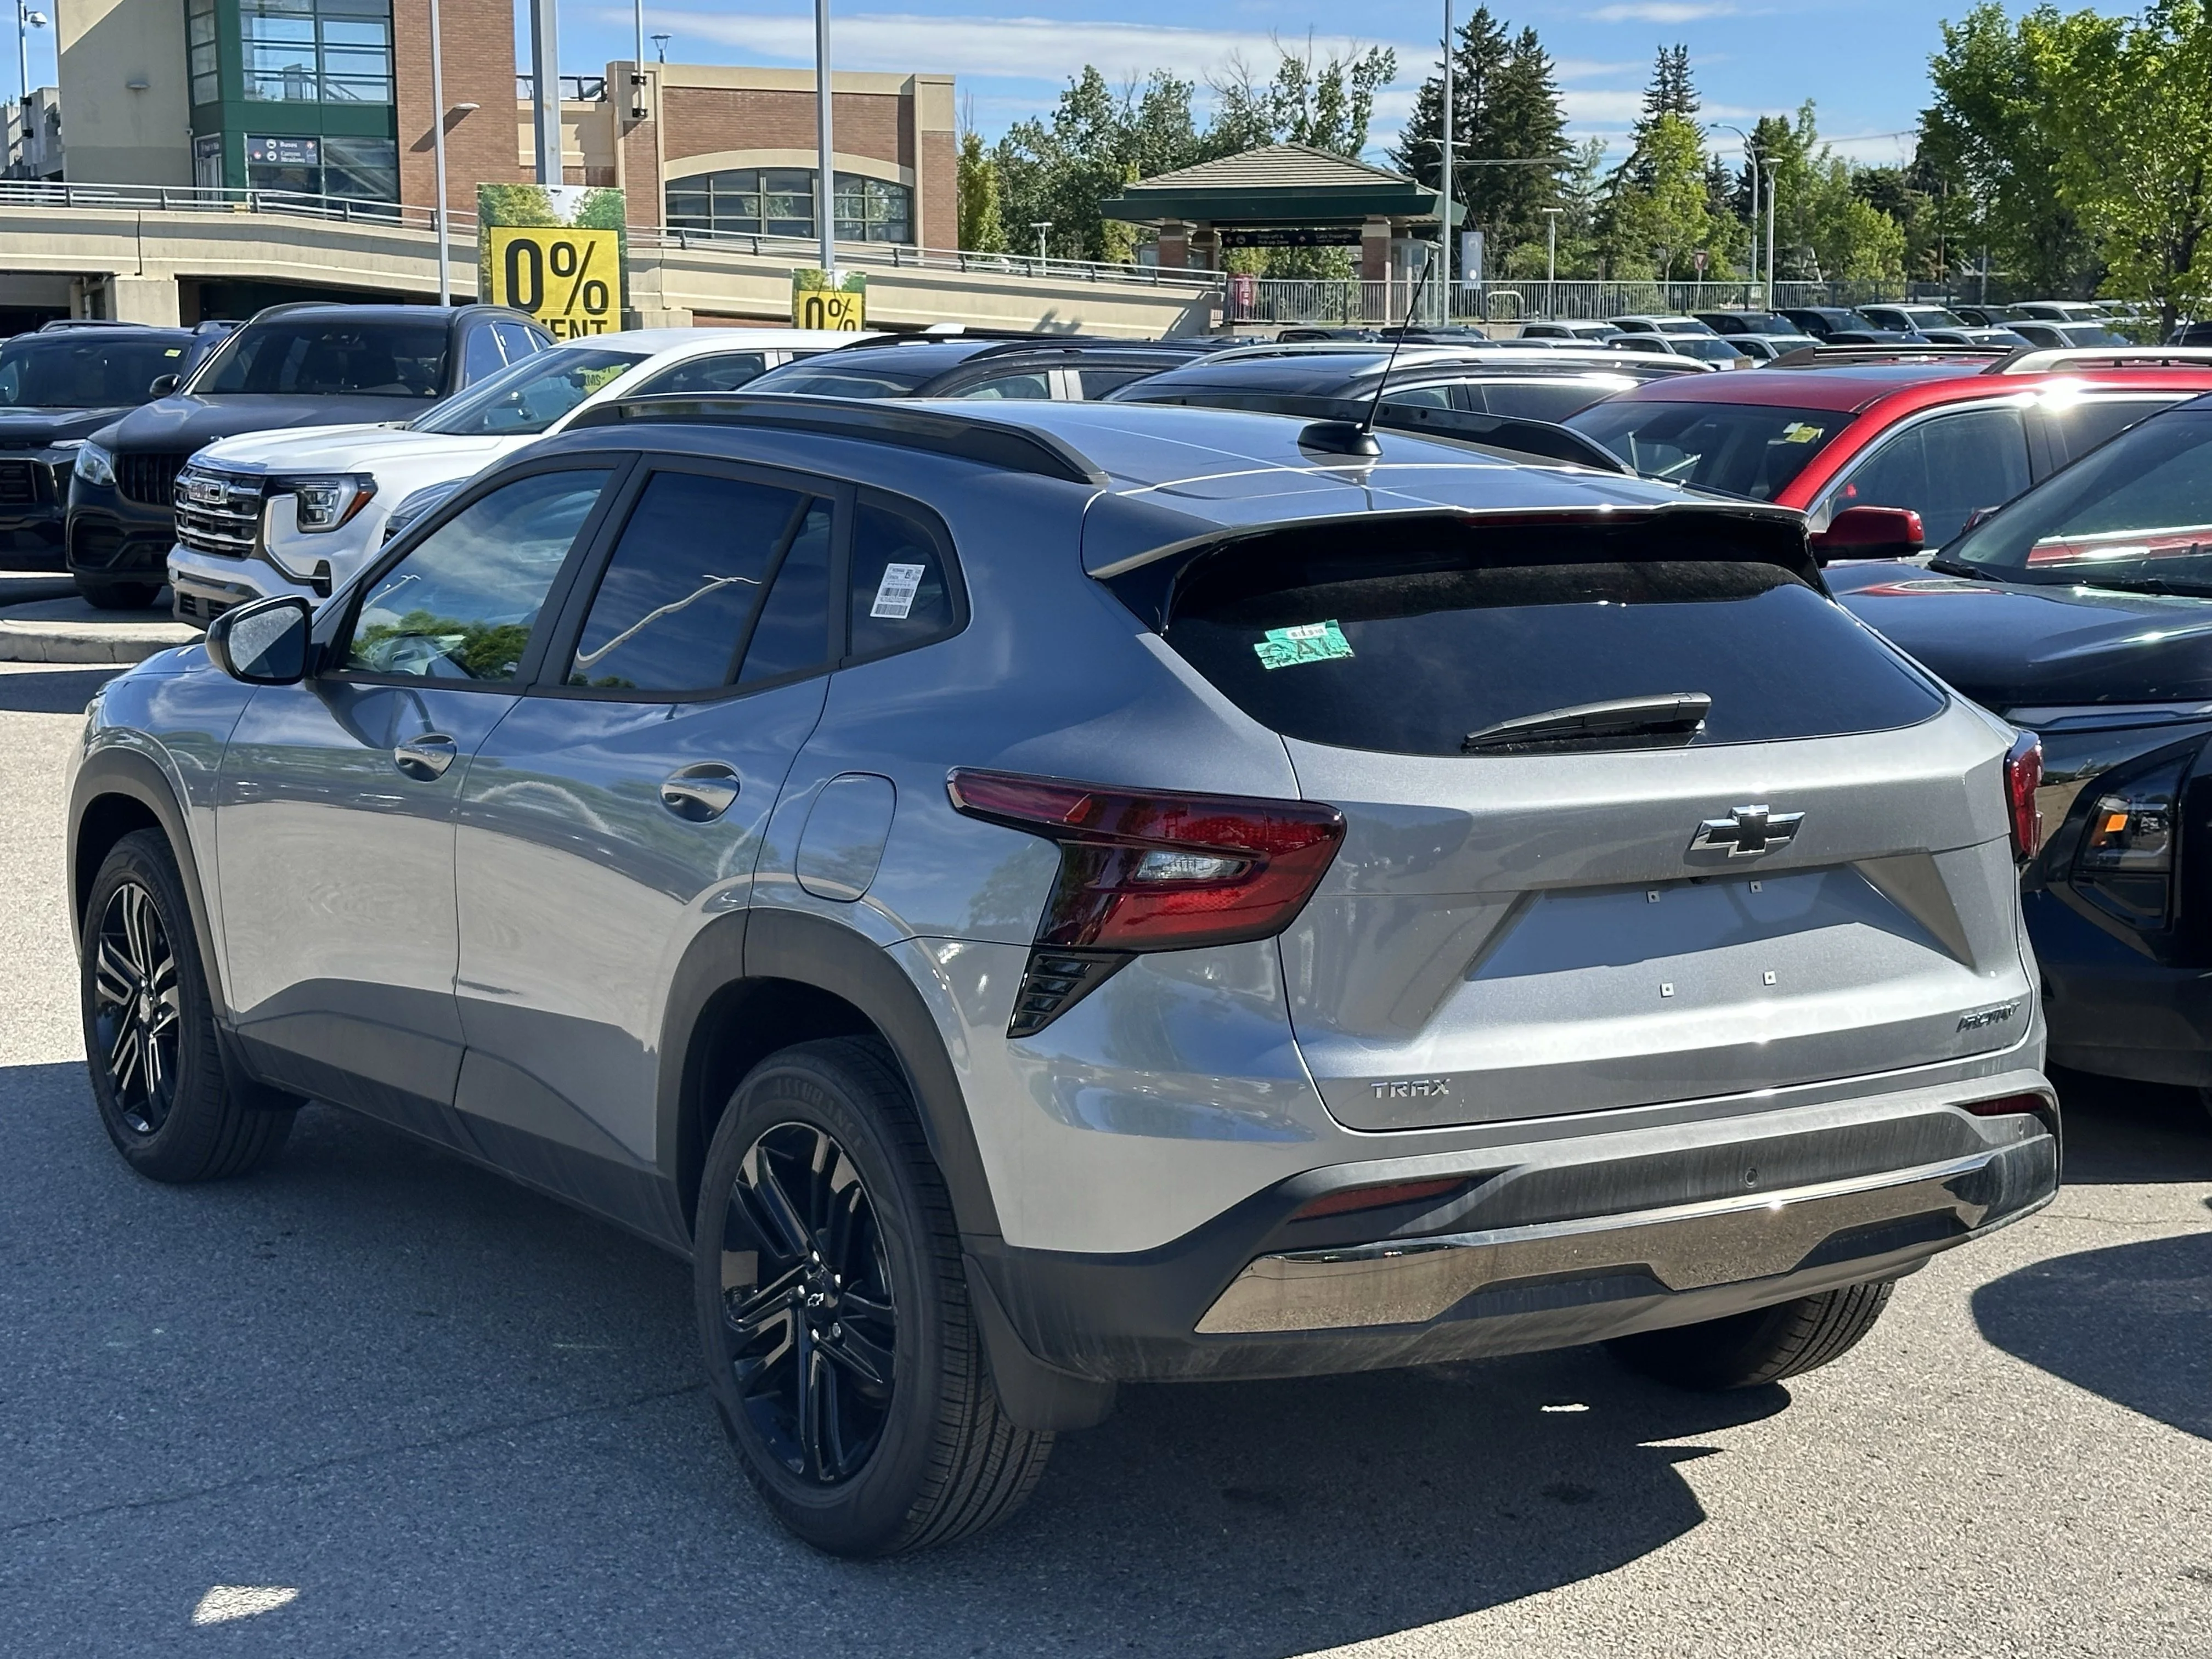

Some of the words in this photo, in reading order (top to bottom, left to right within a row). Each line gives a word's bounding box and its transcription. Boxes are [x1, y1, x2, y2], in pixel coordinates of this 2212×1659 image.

[505, 239, 609, 315] 0%
[806, 297, 856, 331] 0%
[541, 319, 607, 340] ENT
[1369, 1078, 1450, 1098] TRAX
